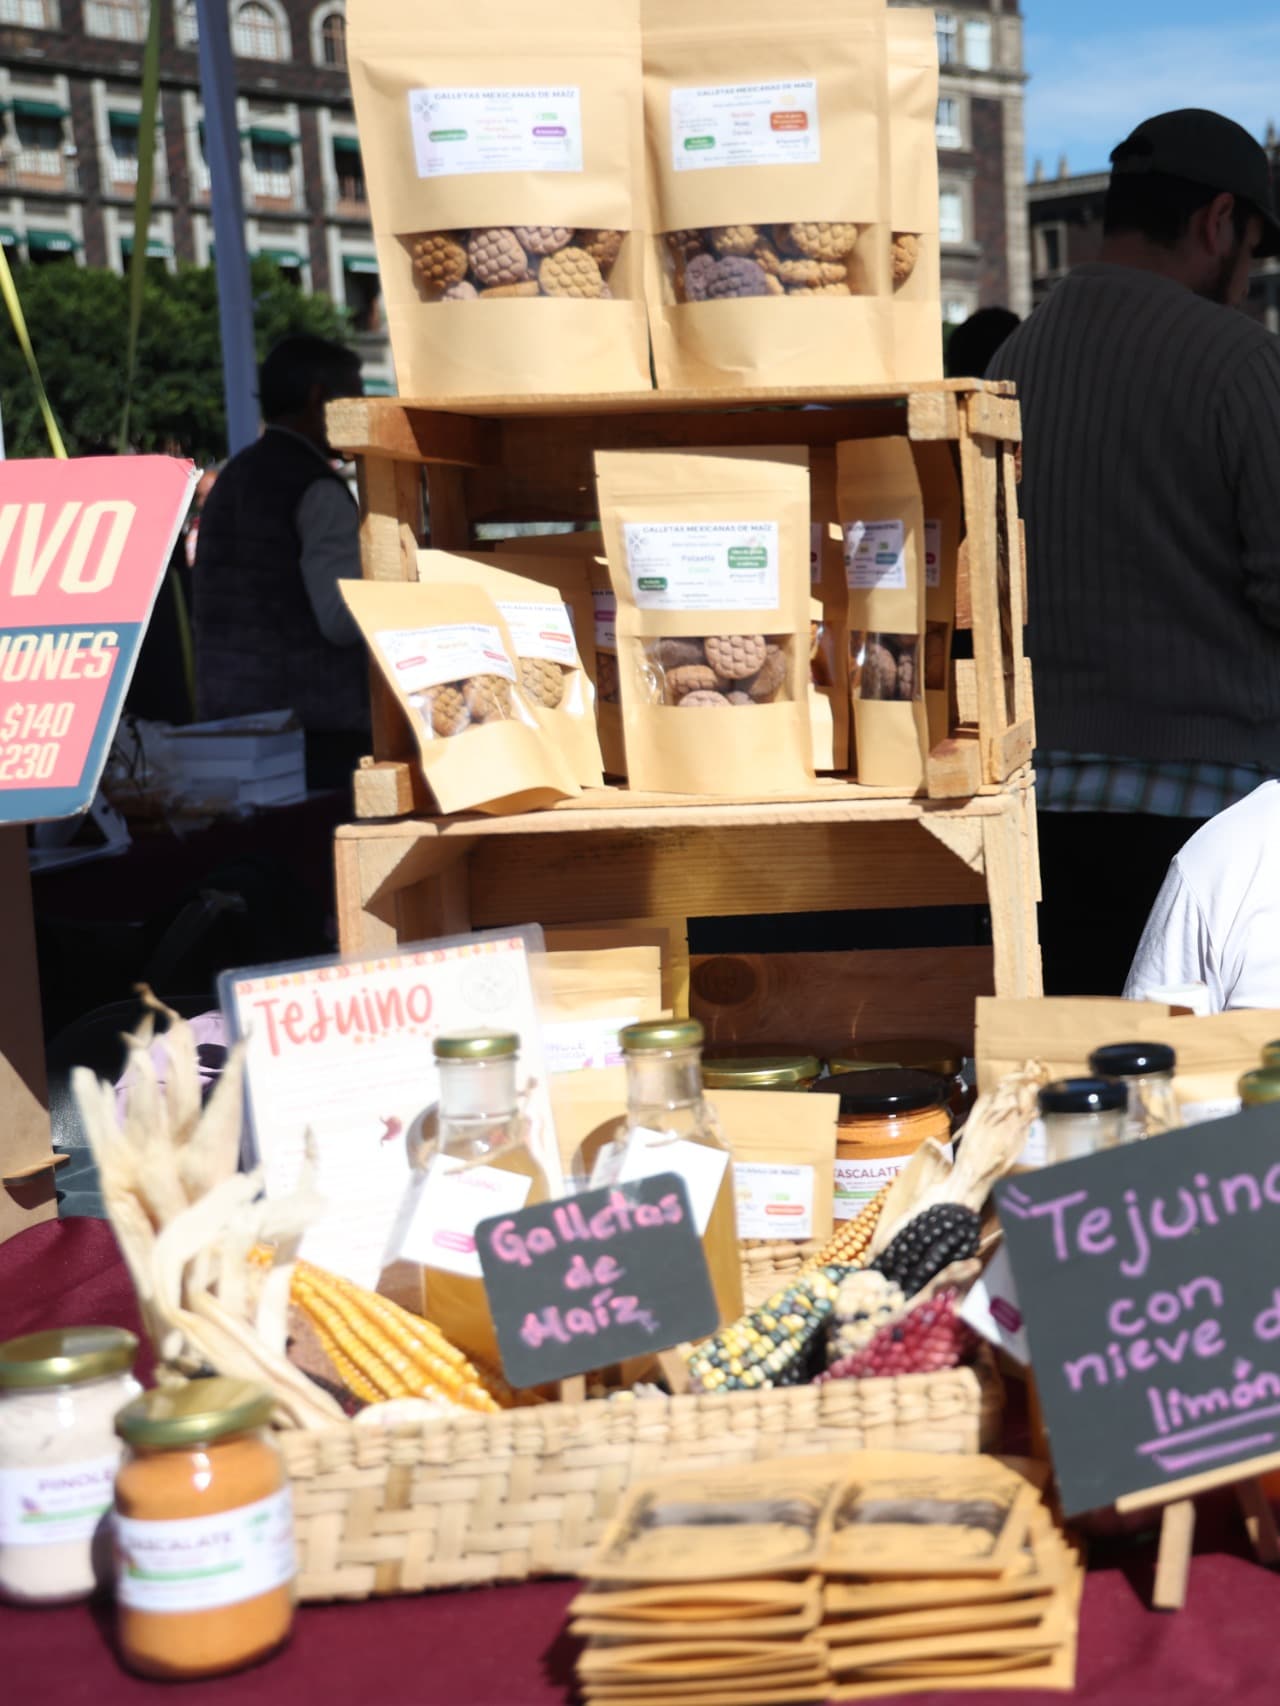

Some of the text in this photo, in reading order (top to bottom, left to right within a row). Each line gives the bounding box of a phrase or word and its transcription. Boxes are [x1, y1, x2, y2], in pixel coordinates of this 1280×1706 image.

[0, 702, 76, 742] $140
[0, 742, 60, 781] 230
[833, 1165, 902, 1179] ASCALATE
[489, 1190, 684, 1267] Galletas
[564, 1254, 625, 1291] de
[1107, 1274, 1224, 1336] con
[1063, 1317, 1226, 1392] nieve
